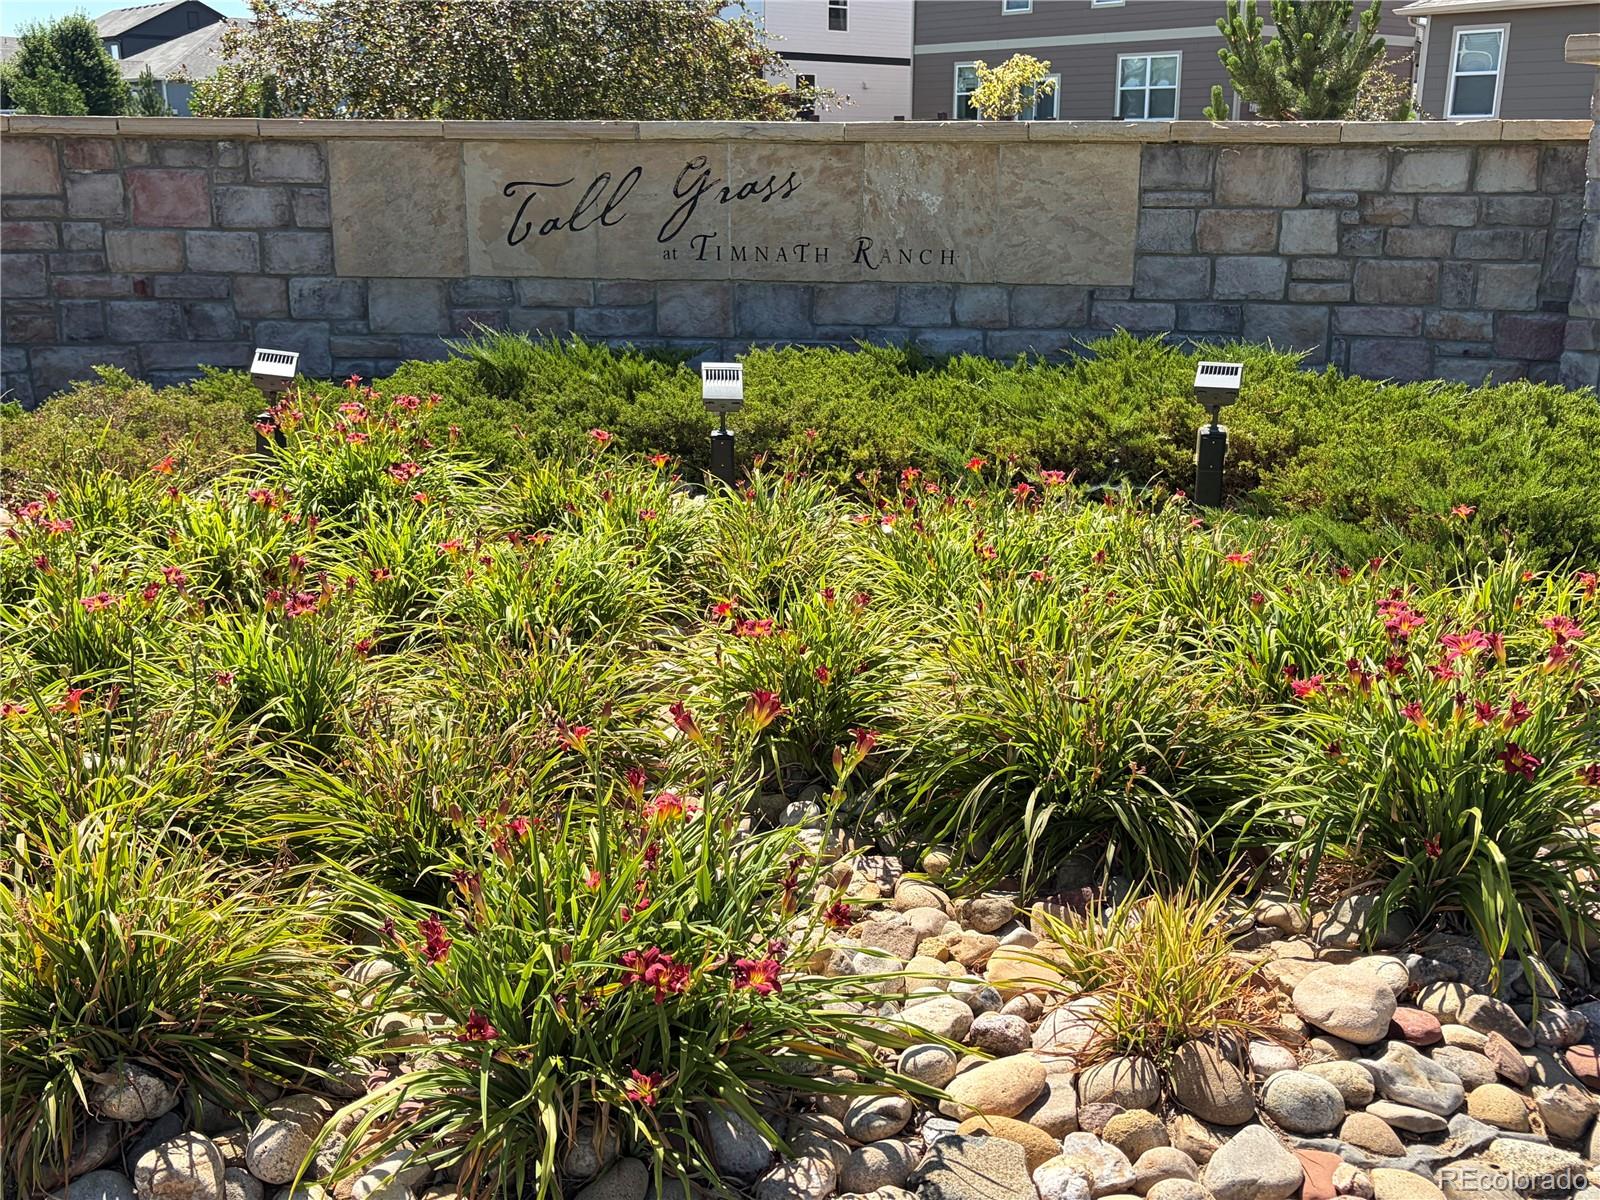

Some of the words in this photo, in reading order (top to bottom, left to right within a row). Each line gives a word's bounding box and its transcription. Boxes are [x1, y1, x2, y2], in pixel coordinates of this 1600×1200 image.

[503, 166, 643, 246] Tall
[656, 155, 802, 242] Grass
[662, 246, 678, 260] at
[690, 231, 829, 264] TIMNATH
[852, 236, 956, 269] RANCH
